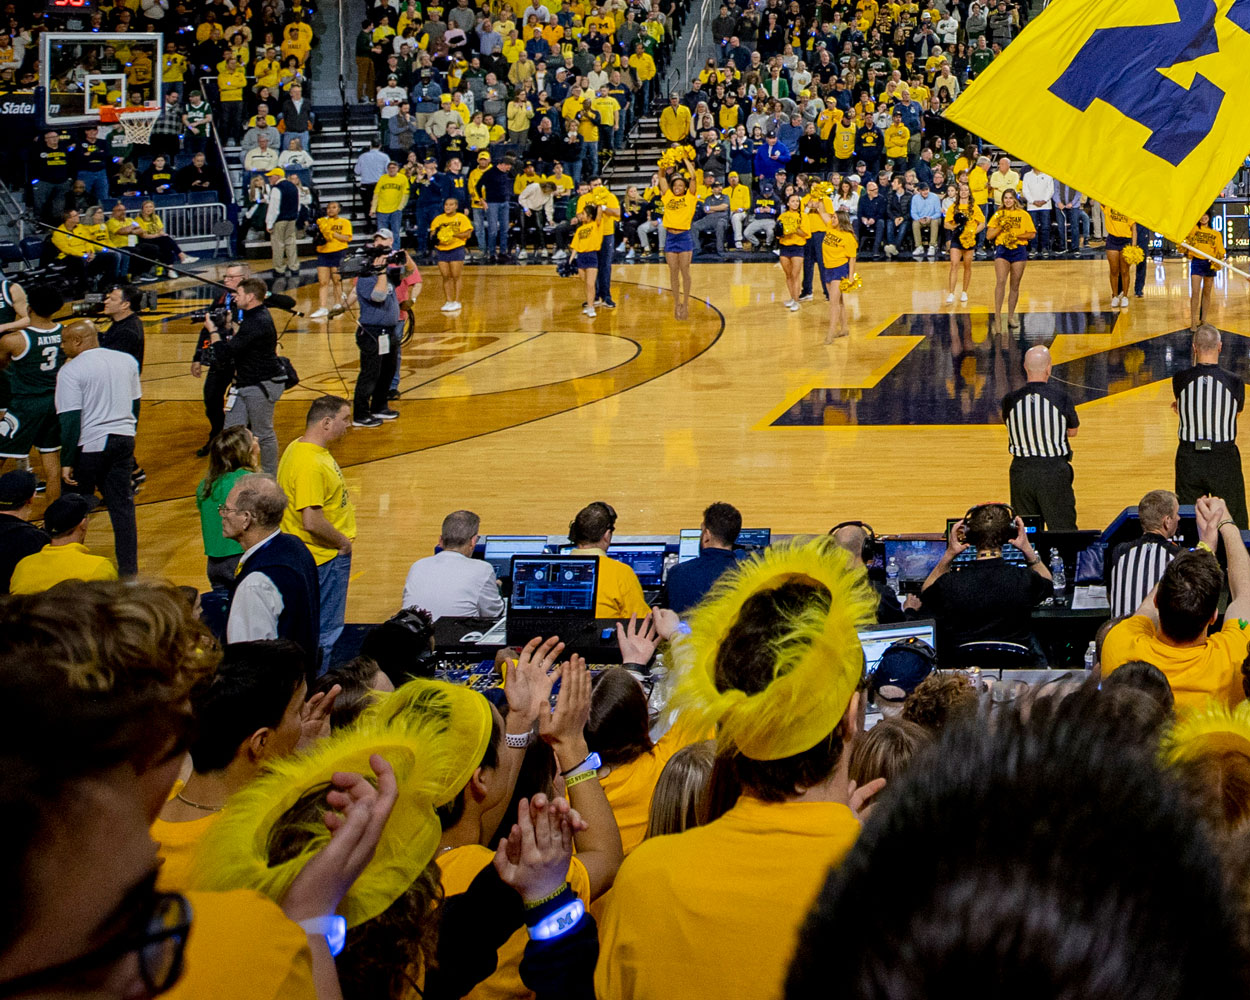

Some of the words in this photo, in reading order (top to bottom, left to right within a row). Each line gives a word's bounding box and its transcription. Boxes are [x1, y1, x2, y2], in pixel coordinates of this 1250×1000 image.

[38, 335, 62, 346] AKINS
[40, 346, 58, 371] 3
[556, 912, 574, 930] M
